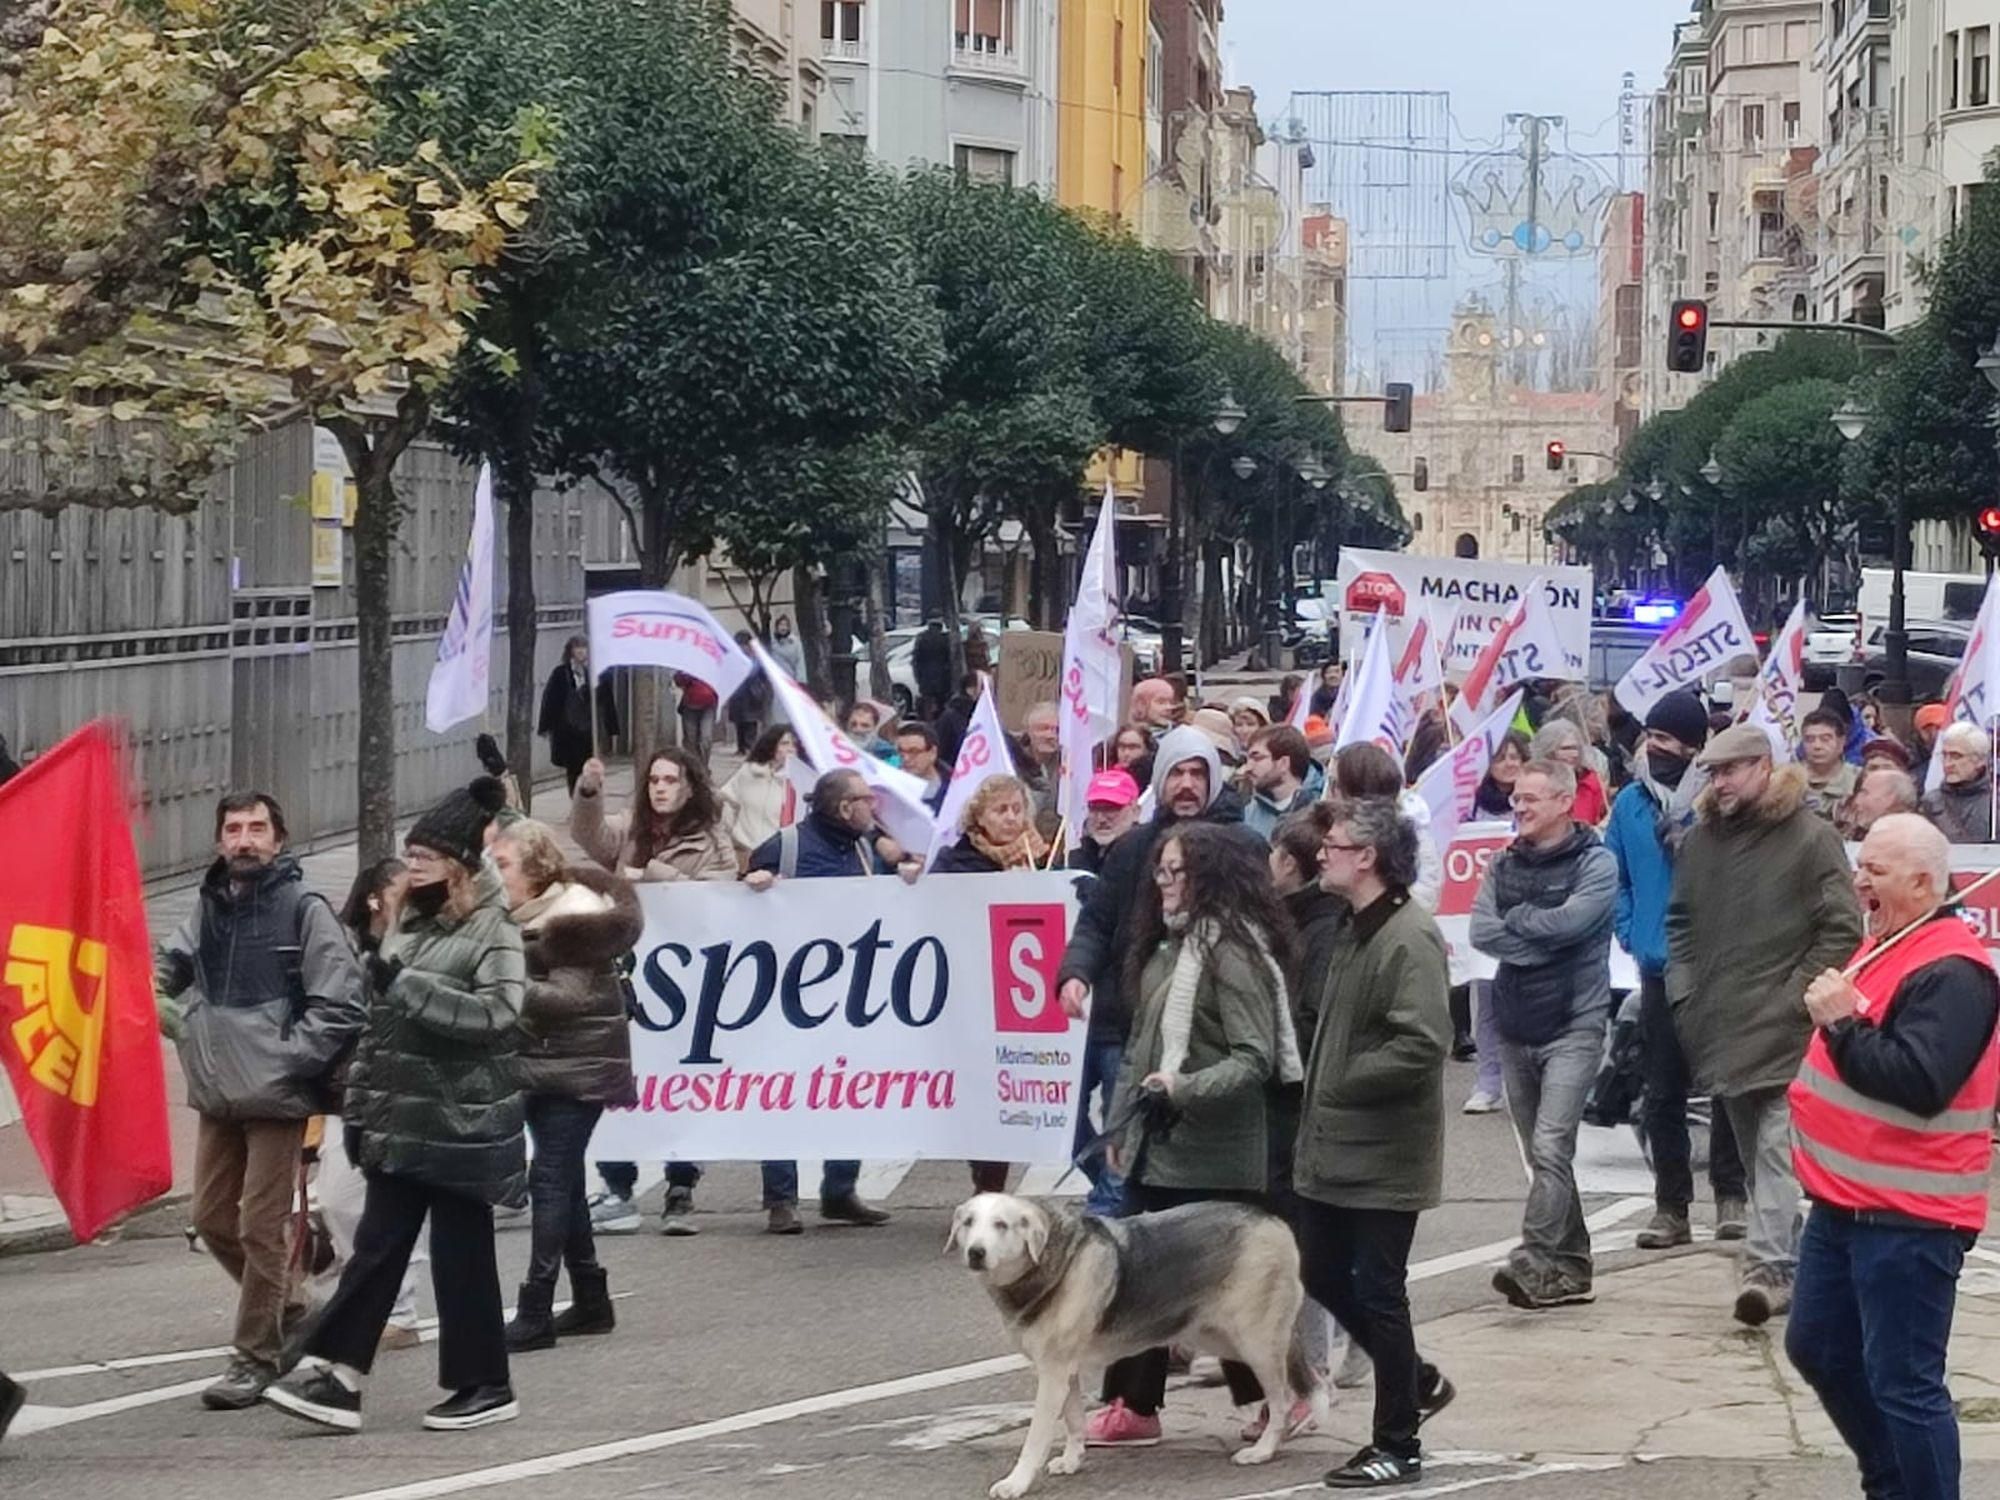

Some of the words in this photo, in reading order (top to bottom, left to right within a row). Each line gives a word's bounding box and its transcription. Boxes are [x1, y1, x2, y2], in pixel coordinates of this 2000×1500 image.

[1356, 582, 1397, 596] STOP
[1421, 576, 1580, 609] MACHAÓN
[1460, 615, 1482, 632] IN
[630, 918, 950, 1064] speto
[1010, 931, 1046, 1019] S
[606, 1067, 797, 1112] uestra
[805, 1055, 956, 1110] tierra
[998, 1069, 1072, 1104] Sumar
